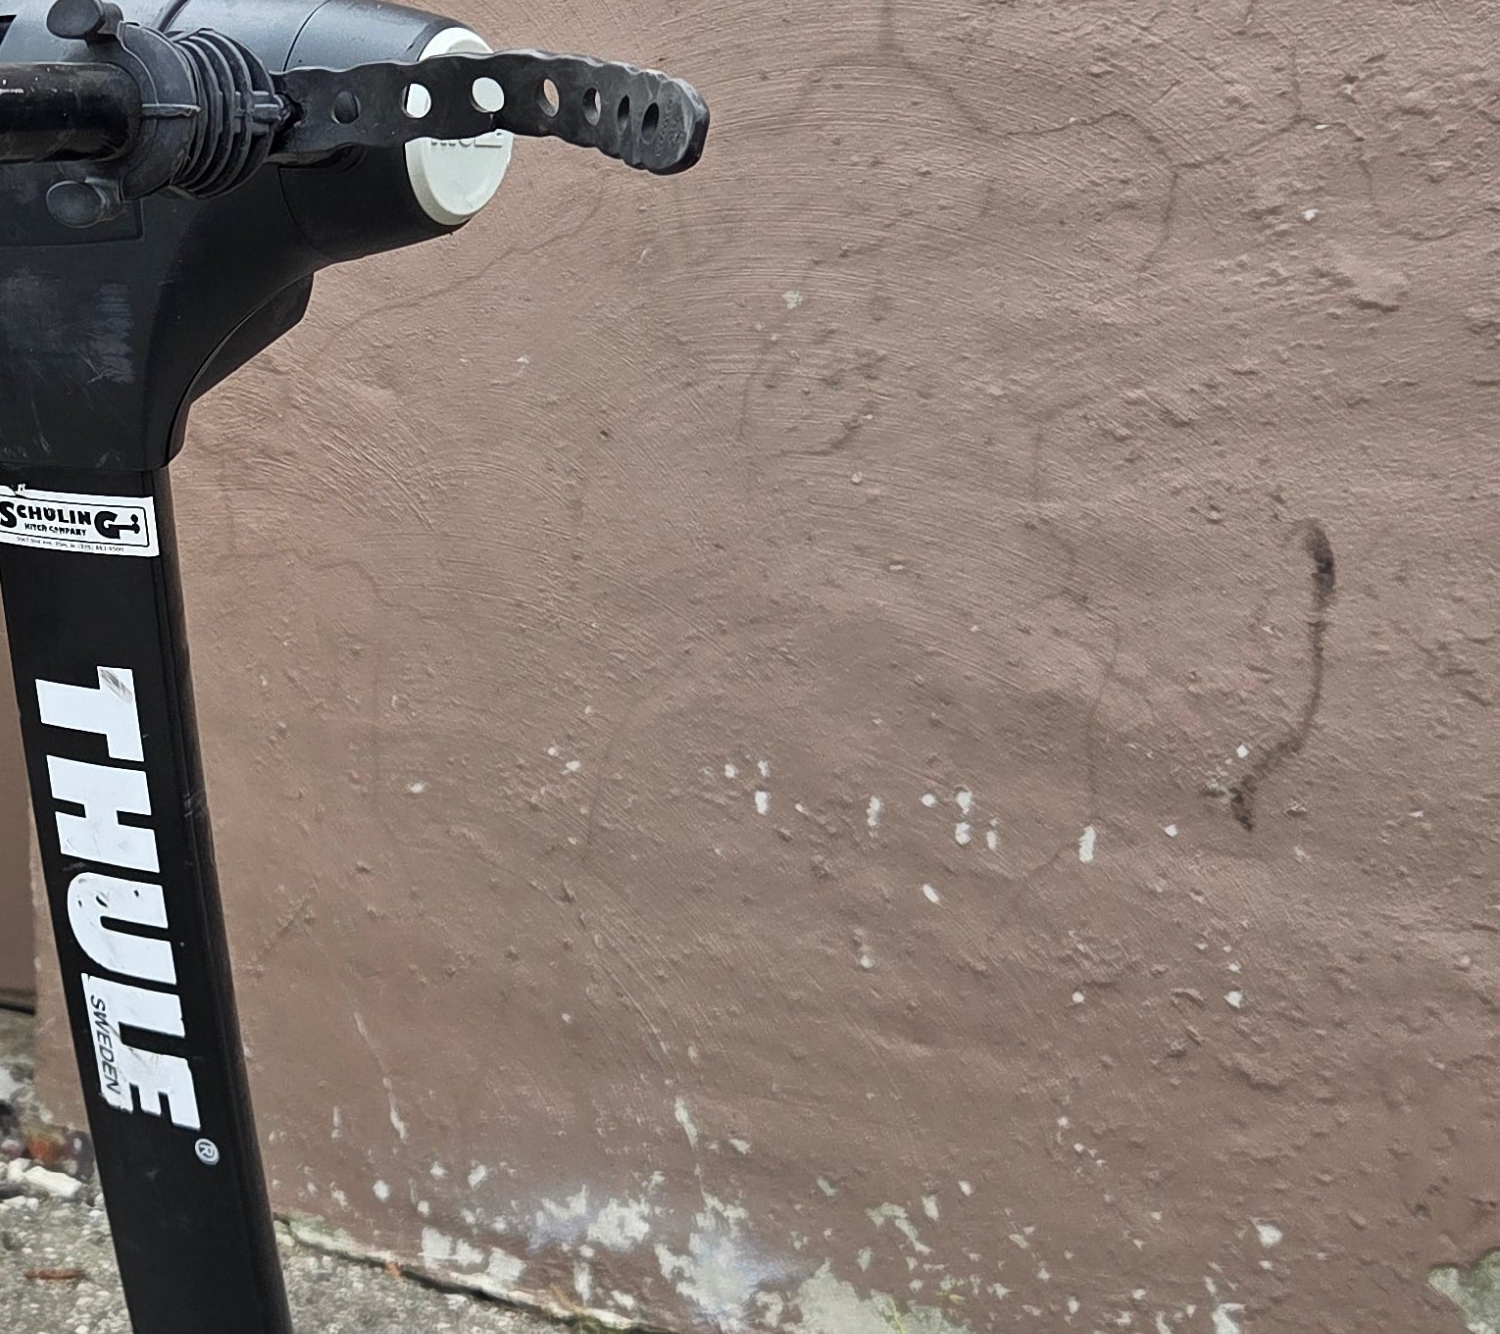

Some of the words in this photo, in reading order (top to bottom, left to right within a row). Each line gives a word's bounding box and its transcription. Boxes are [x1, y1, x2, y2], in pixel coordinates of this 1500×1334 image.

[49, 525, 87, 537] COMPANY
[35, 666, 201, 1131] THULE
[90, 994, 121, 1095] SWEDEN
